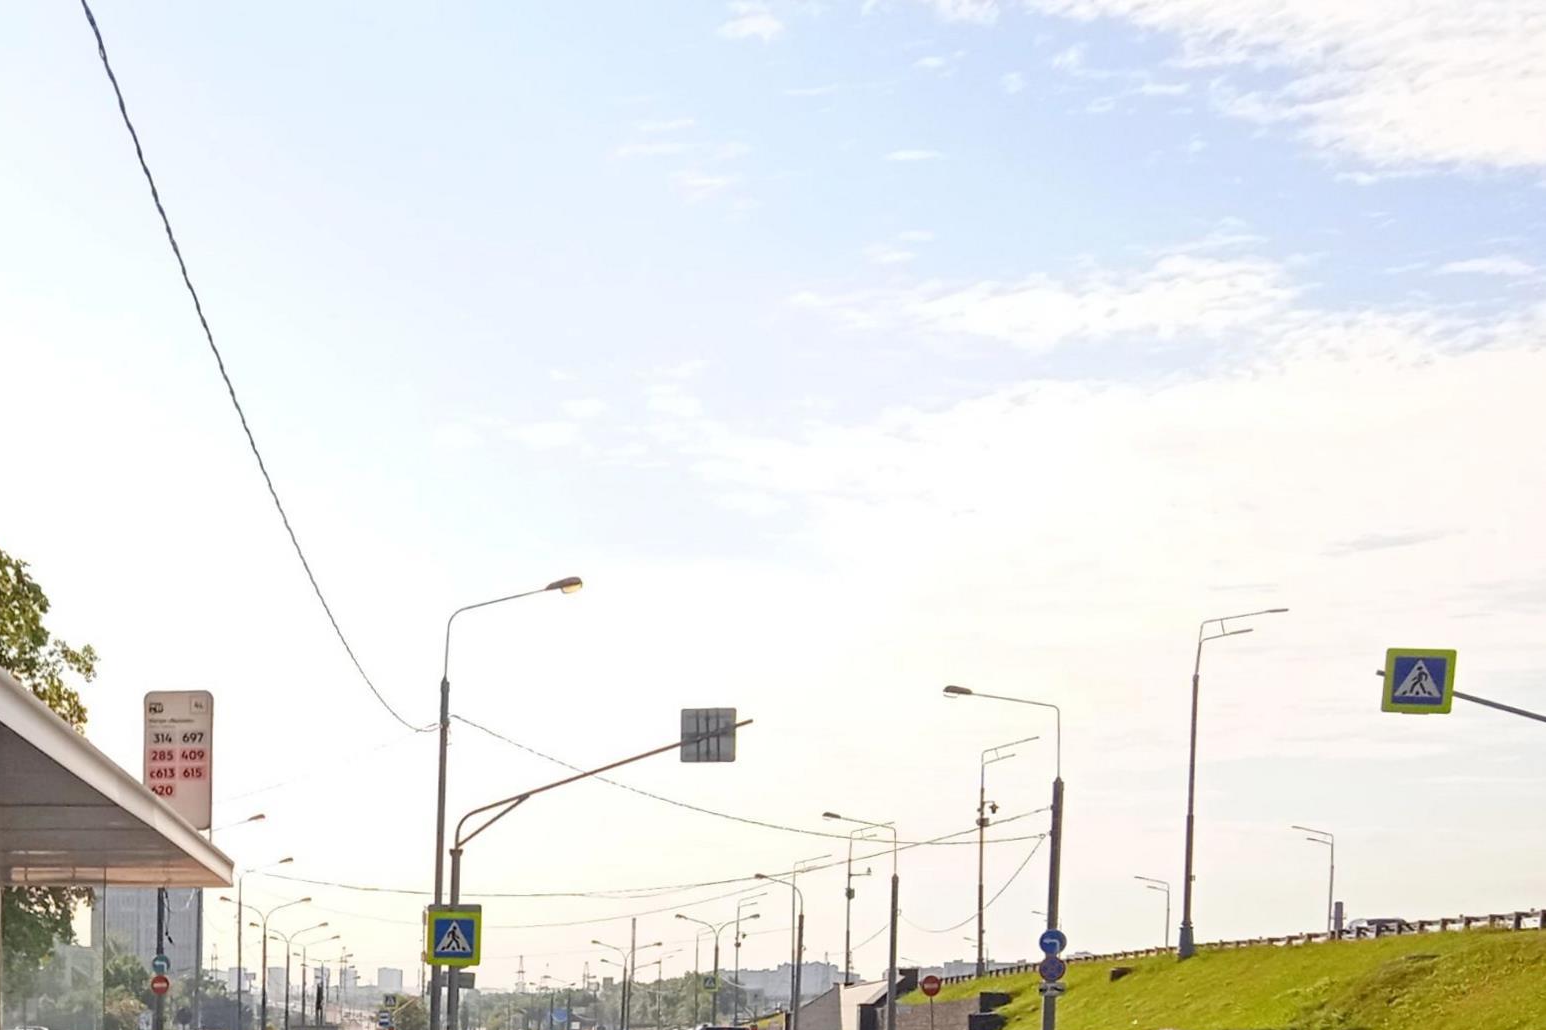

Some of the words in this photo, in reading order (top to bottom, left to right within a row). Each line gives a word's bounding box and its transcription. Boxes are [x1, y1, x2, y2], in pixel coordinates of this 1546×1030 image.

[154, 732, 172, 744] 314
[182, 732, 204, 744] 697
[152, 750, 174, 761] 285
[181, 750, 204, 760] 409
[183, 767, 202, 778] 615
